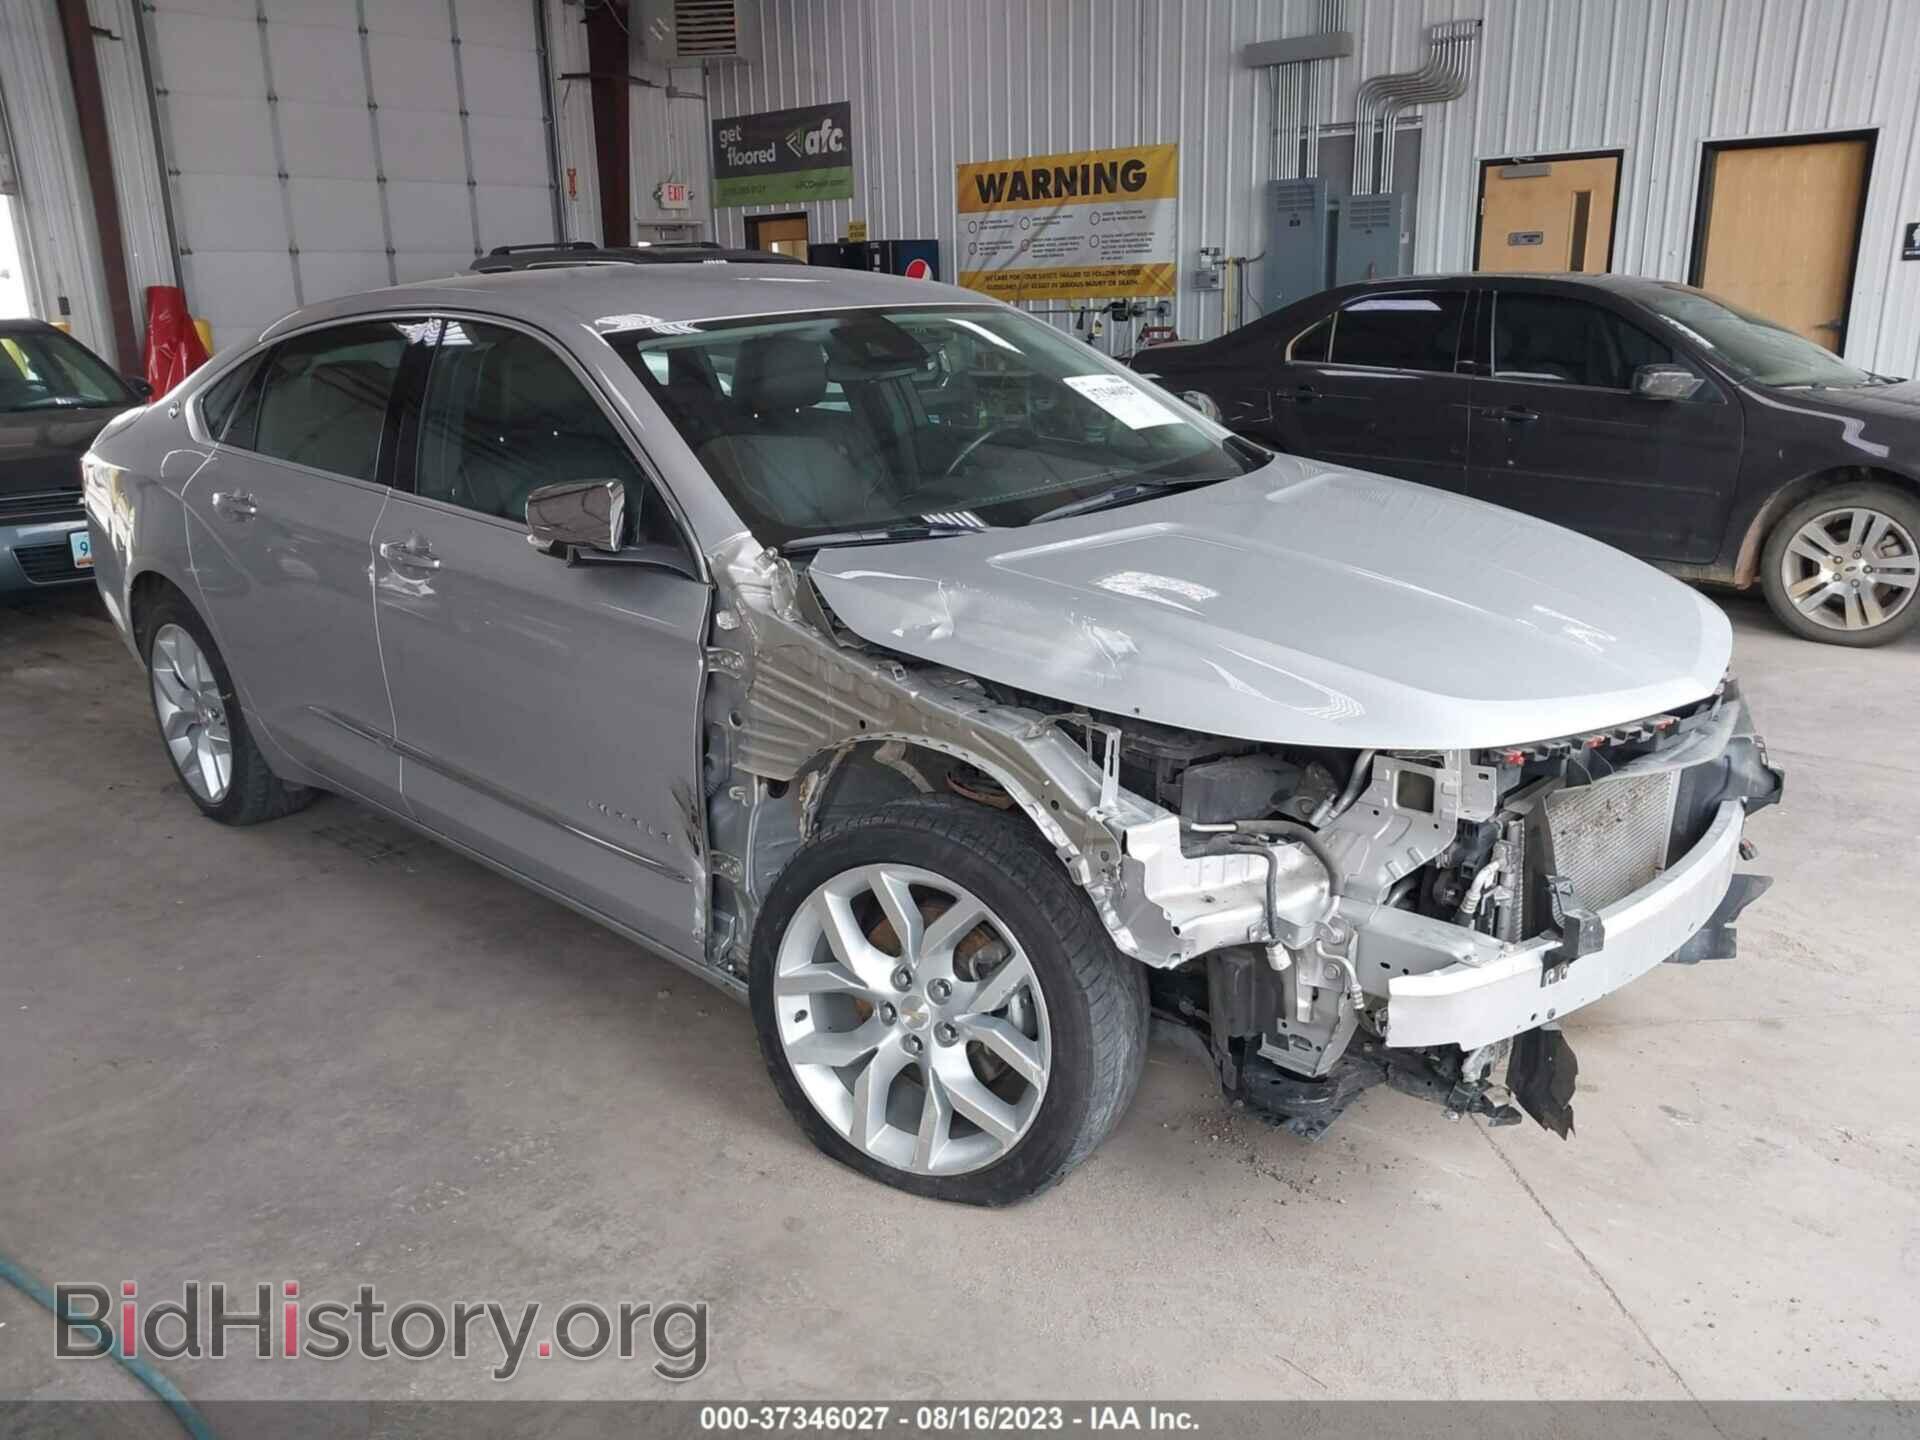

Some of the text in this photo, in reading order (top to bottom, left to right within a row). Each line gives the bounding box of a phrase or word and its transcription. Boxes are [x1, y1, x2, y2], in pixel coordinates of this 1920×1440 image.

[719, 124, 742, 149] get
[805, 118, 844, 156] afc
[727, 142, 776, 167] floored
[668, 184, 685, 201] EXIT
[975, 159, 1147, 204] WARNING
